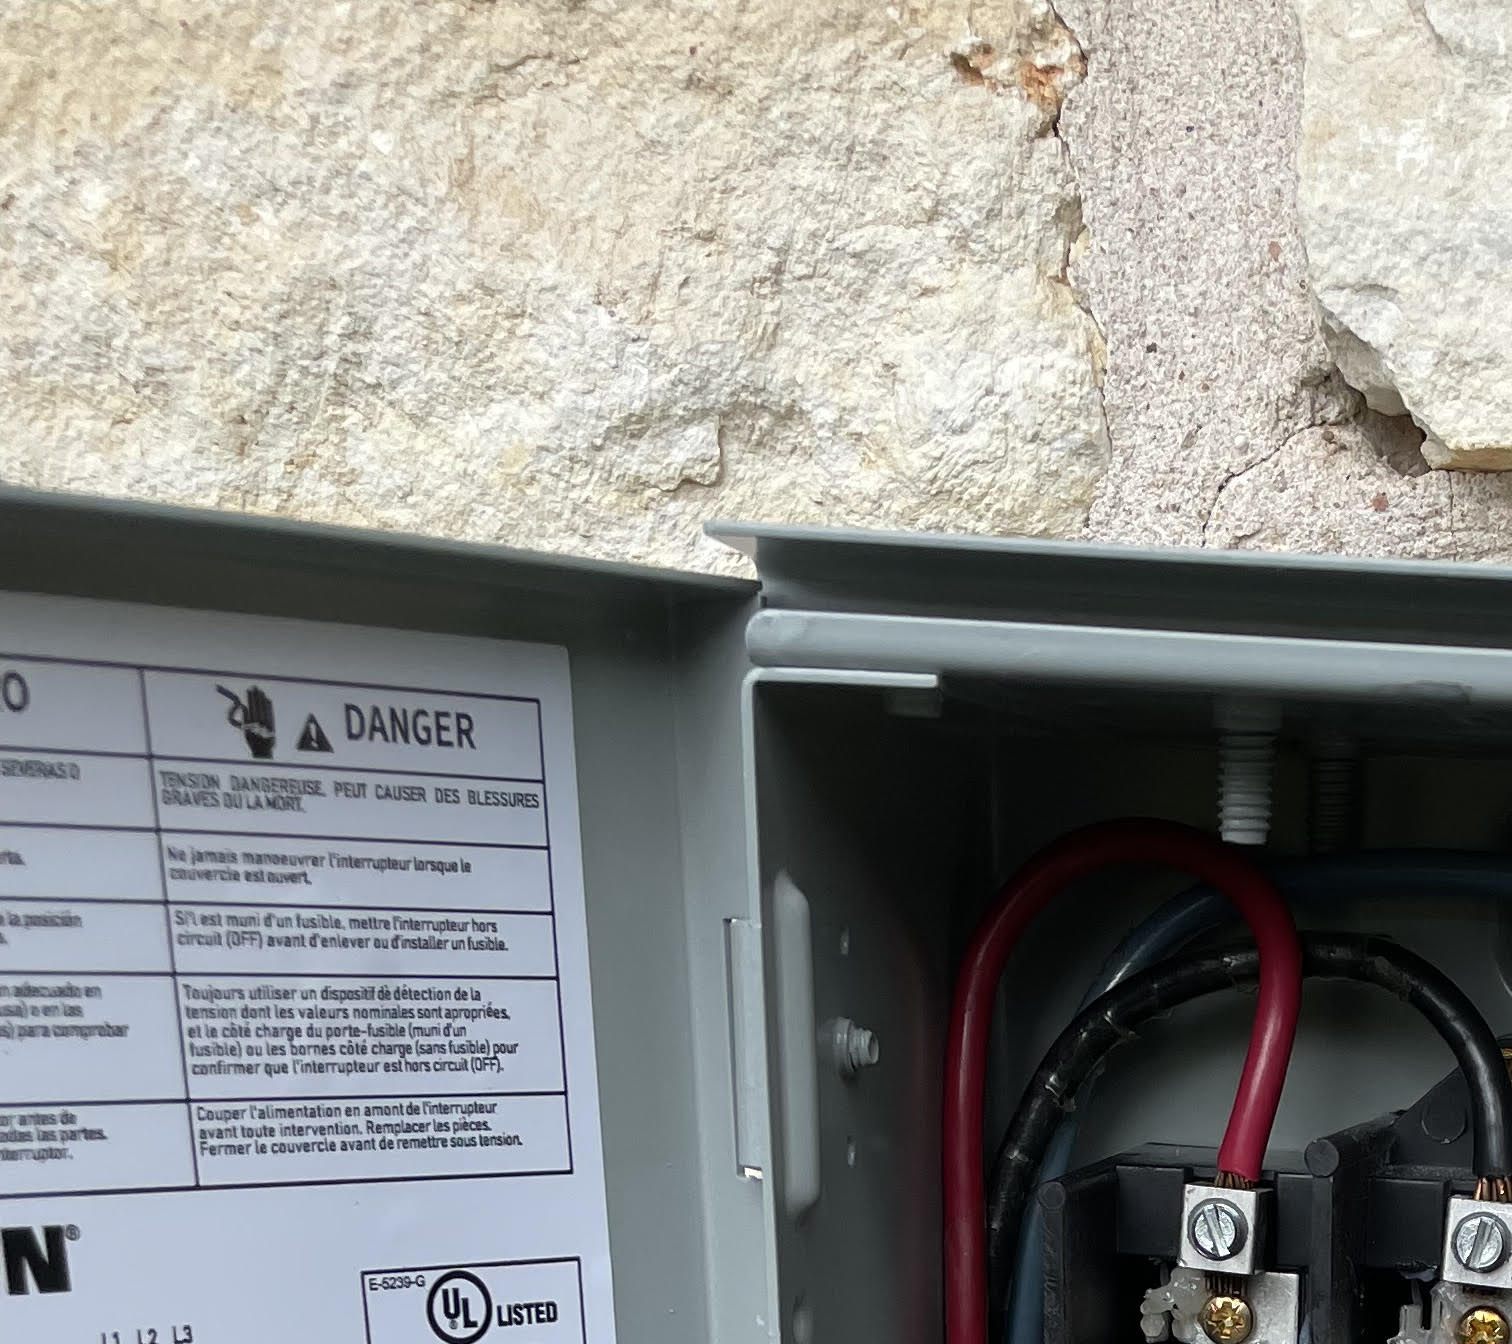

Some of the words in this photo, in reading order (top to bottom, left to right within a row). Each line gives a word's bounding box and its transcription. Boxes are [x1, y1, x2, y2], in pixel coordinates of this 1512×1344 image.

[344, 702, 476, 749] DANGER
[197, 1106, 247, 1123] Couper
[250, 1105, 342, 1120] l'alimentation
[344, 1107, 360, 1117] en
[364, 1103, 404, 1117] amont
[406, 1102, 421, 1116] de
[423, 1101, 498, 1118] l'interrupteur
[199, 1126, 238, 1140] avant
[240, 1125, 276, 1138] toute
[366, 1120, 431, 1138] Remplacer
[433, 1119, 451, 1132] les
[200, 1142, 252, 1156] Fermer
[255, 1140, 268, 1155] le
[270, 1138, 337, 1154] couvercle
[340, 1138, 376, 1152] avant
[378, 1136, 395, 1150] de
[396, 1136, 448, 1150] remettre
[450, 1136, 478, 1148] sous
[496, 1301, 558, 1327] LISTED
[171, 1325, 193, 1344] L3
